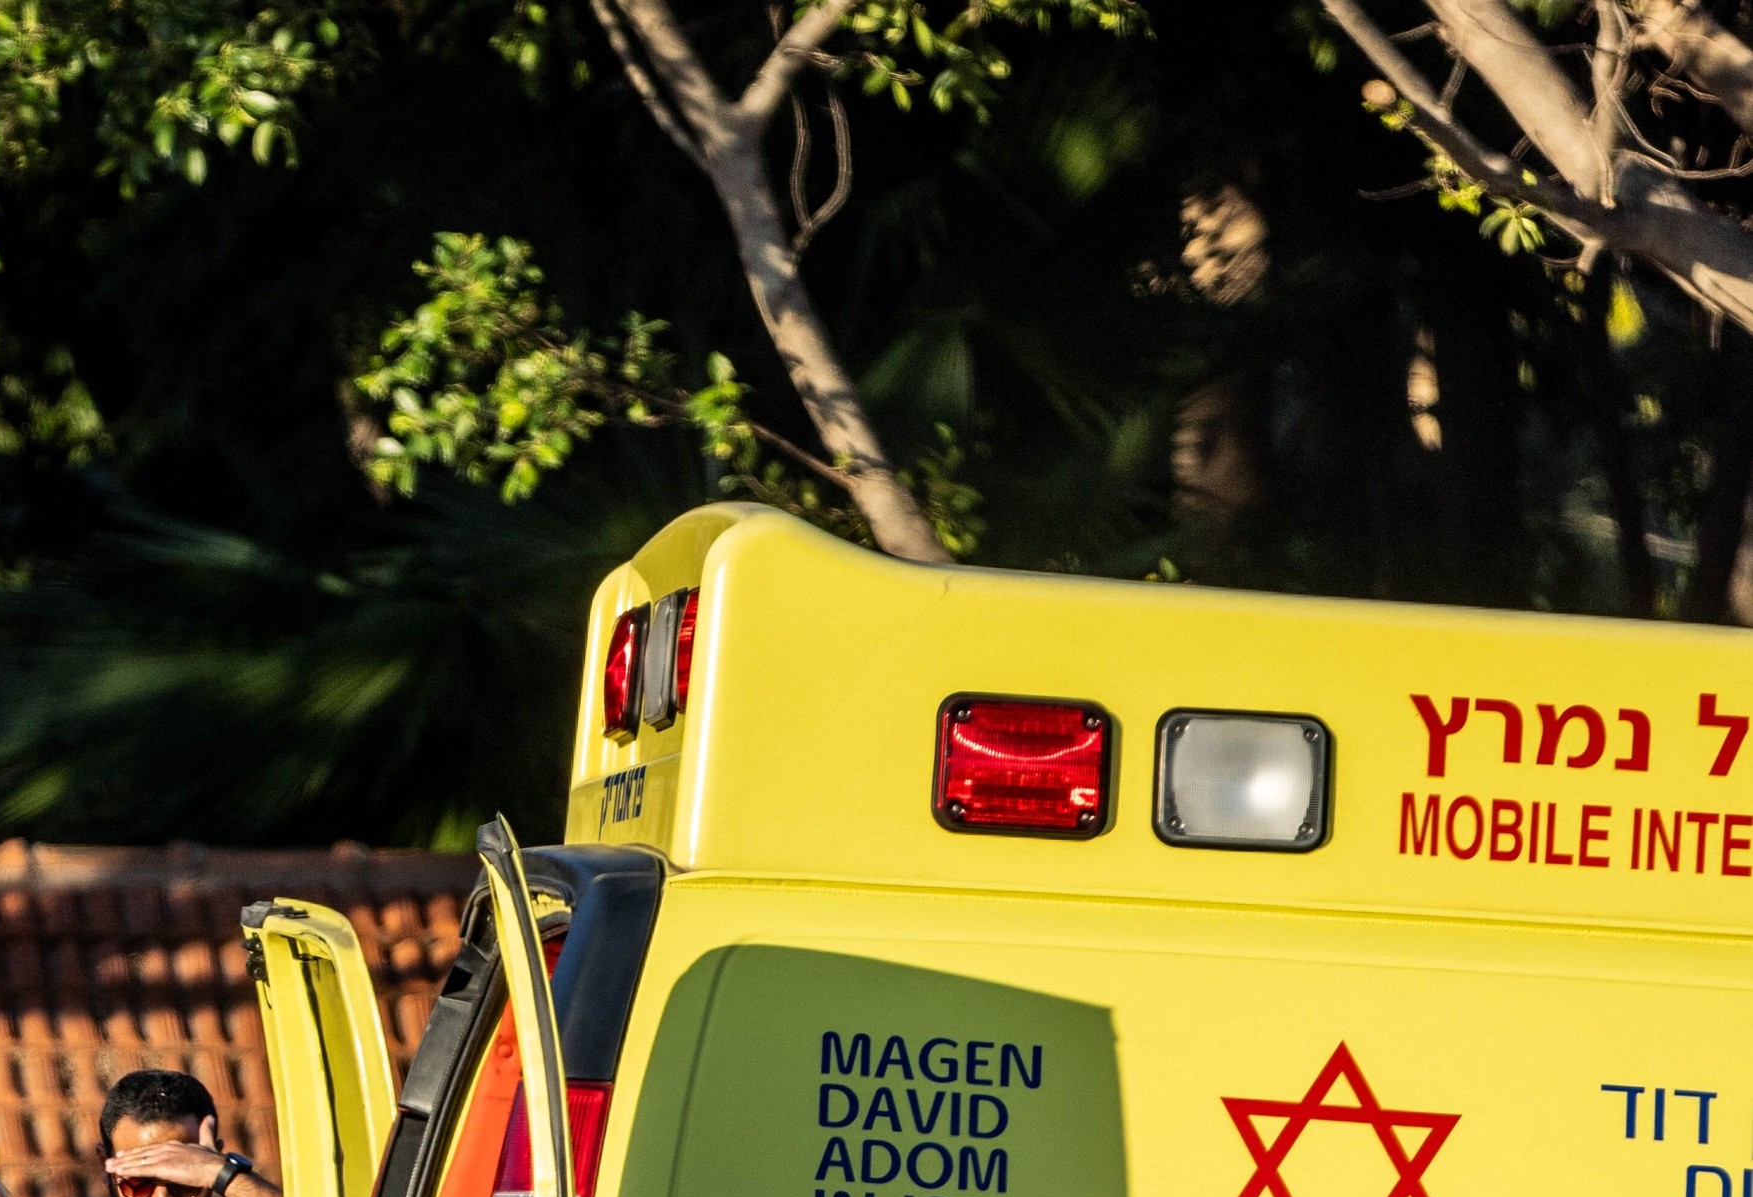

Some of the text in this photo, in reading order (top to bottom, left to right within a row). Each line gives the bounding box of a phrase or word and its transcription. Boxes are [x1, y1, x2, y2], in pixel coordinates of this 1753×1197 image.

[1409, 693, 1652, 778] נמרץ
[1399, 792, 1753, 877] MOBILE INTE
[820, 1031, 1043, 1089] MAGEN
[818, 1083, 1009, 1139] DAVID
[1600, 1084, 1718, 1144] דוד
[814, 1136, 1008, 1193] ADOM
